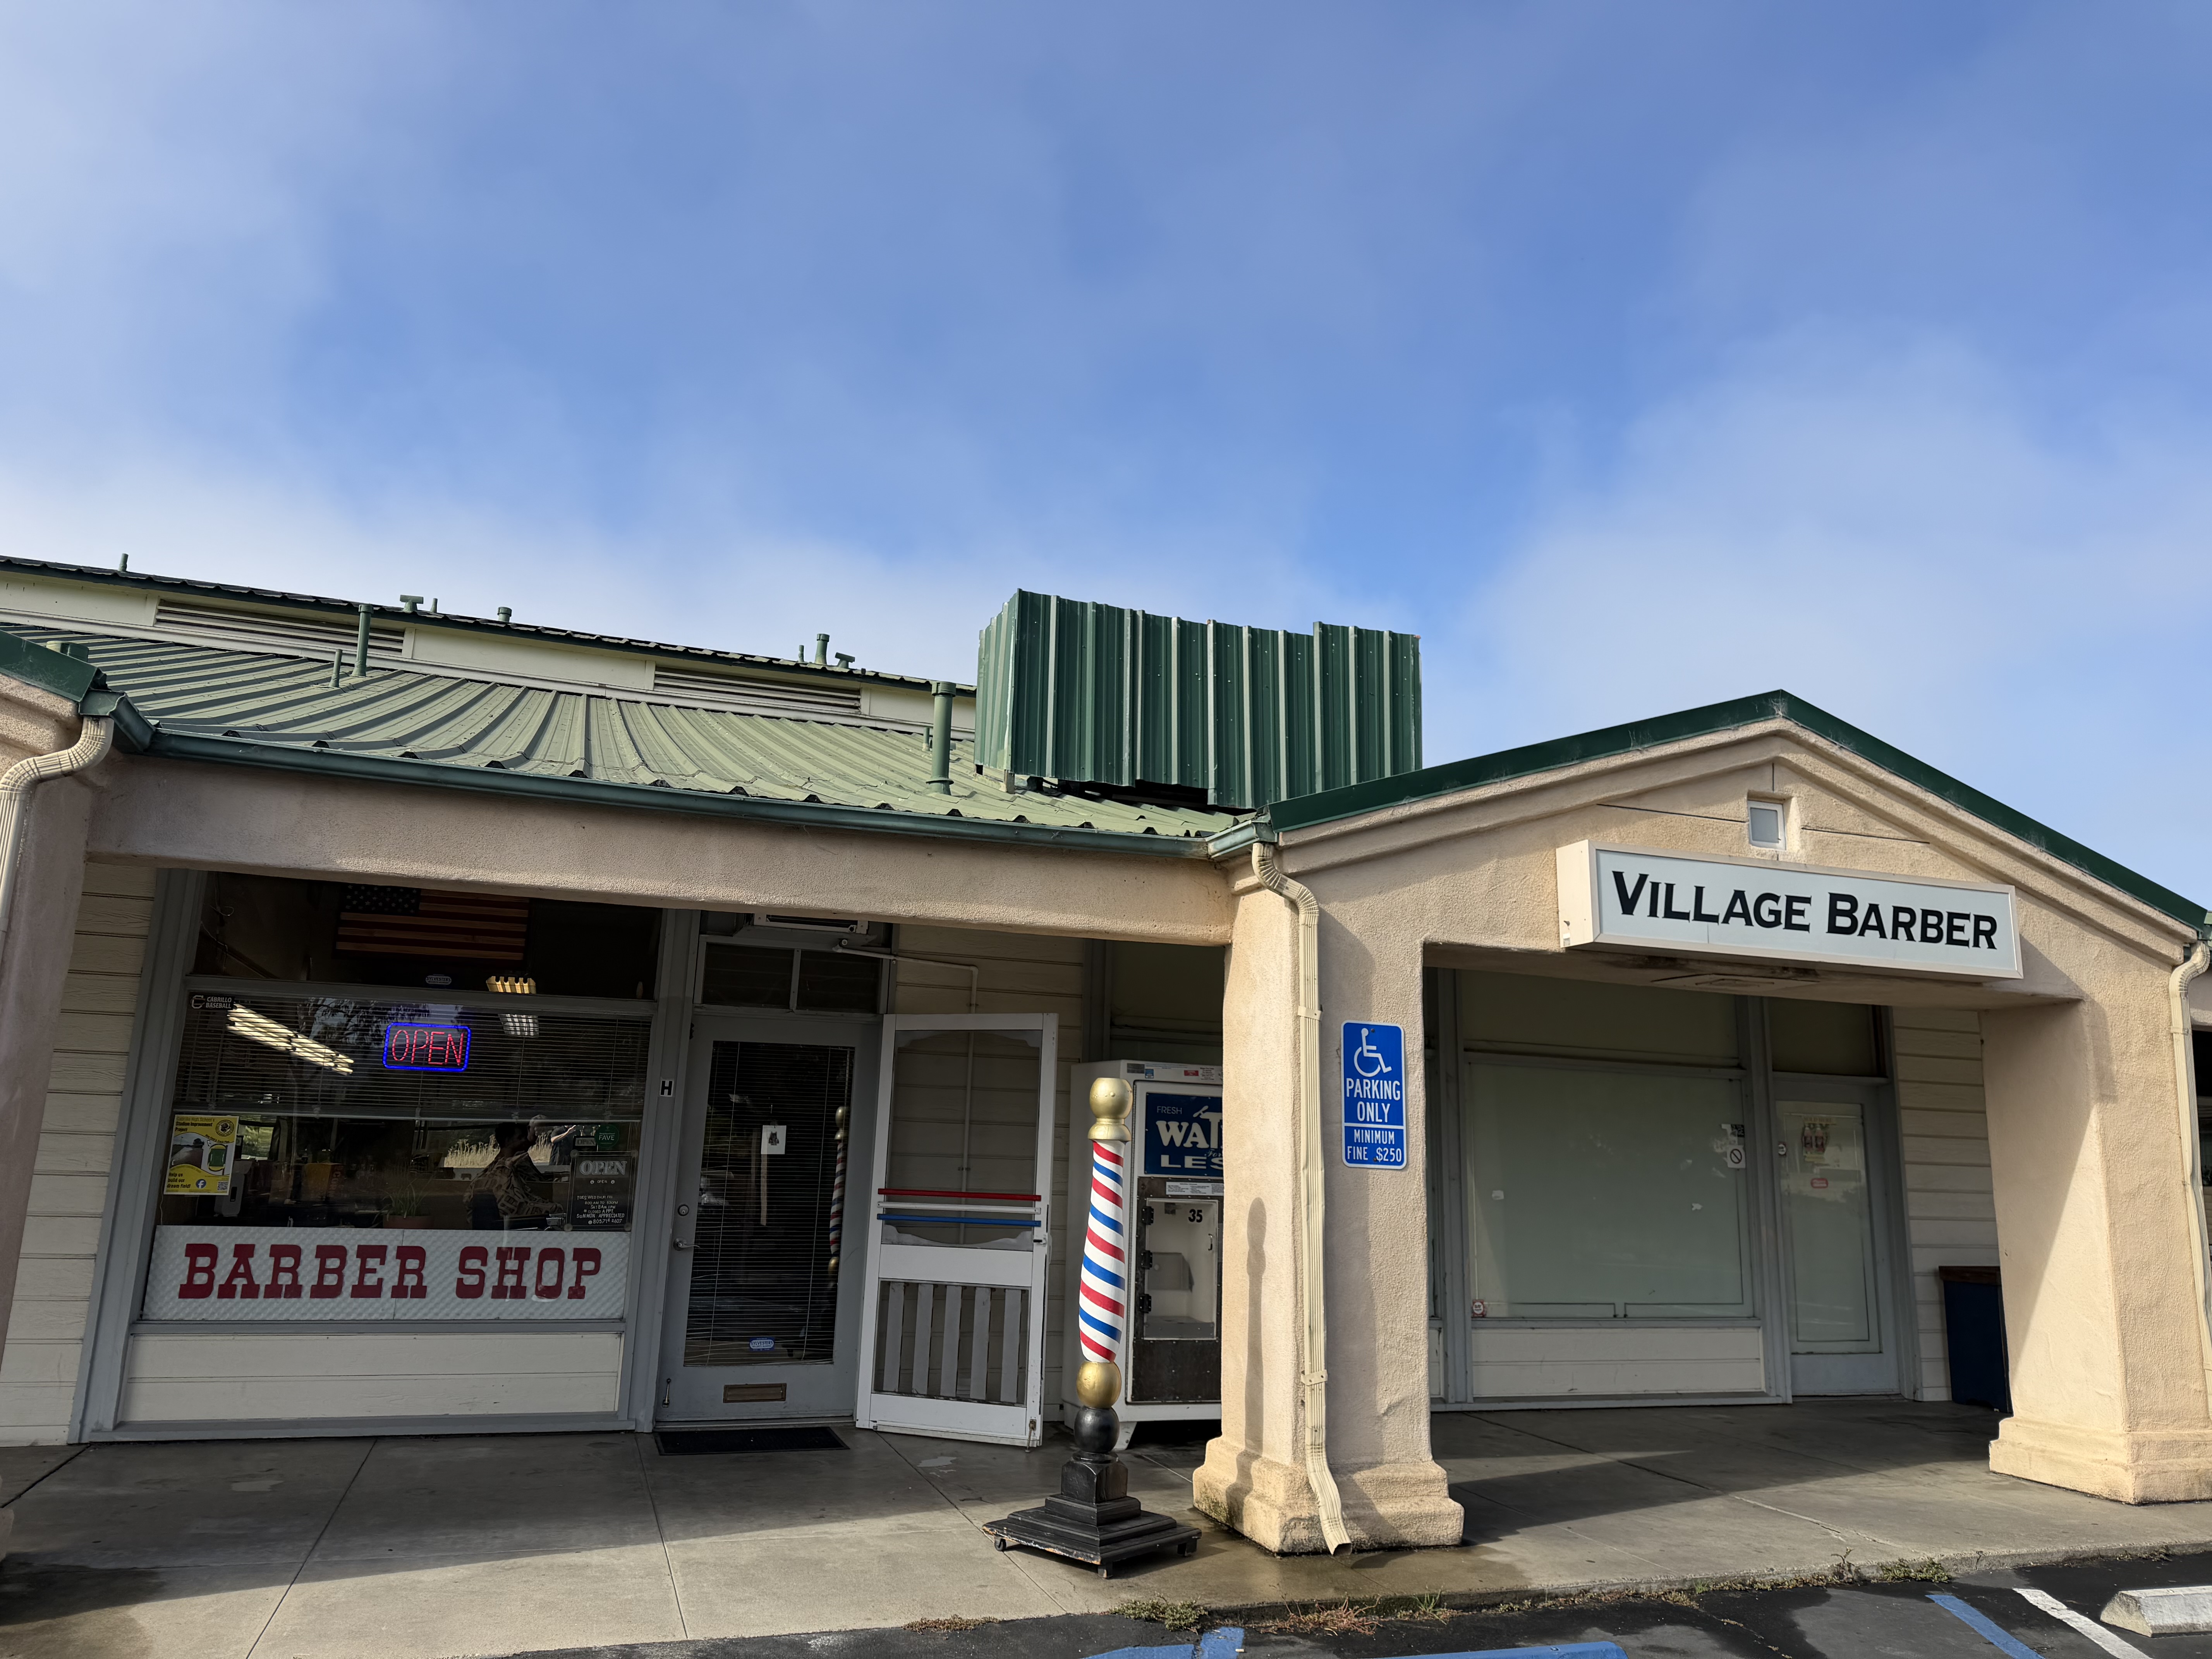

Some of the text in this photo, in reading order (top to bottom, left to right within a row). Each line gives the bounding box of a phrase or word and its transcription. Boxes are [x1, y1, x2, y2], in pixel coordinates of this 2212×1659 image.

[1611, 871, 1998, 950] VILLAGE BARBER
[392, 1029, 464, 1066] OPEN
[661, 1080, 673, 1095] H
[1346, 1078, 1401, 1101] PARKING
[1156, 1106, 1182, 1115] FRESH
[1357, 1101, 1391, 1123] ONLY
[1354, 1129, 1395, 1145] MINIMUM
[1347, 1146, 1402, 1163] FINE $250
[579, 1160, 627, 1175] OPEN
[1188, 1209, 1203, 1223] 35
[178, 1243, 601, 1299] BARBER SHOP
